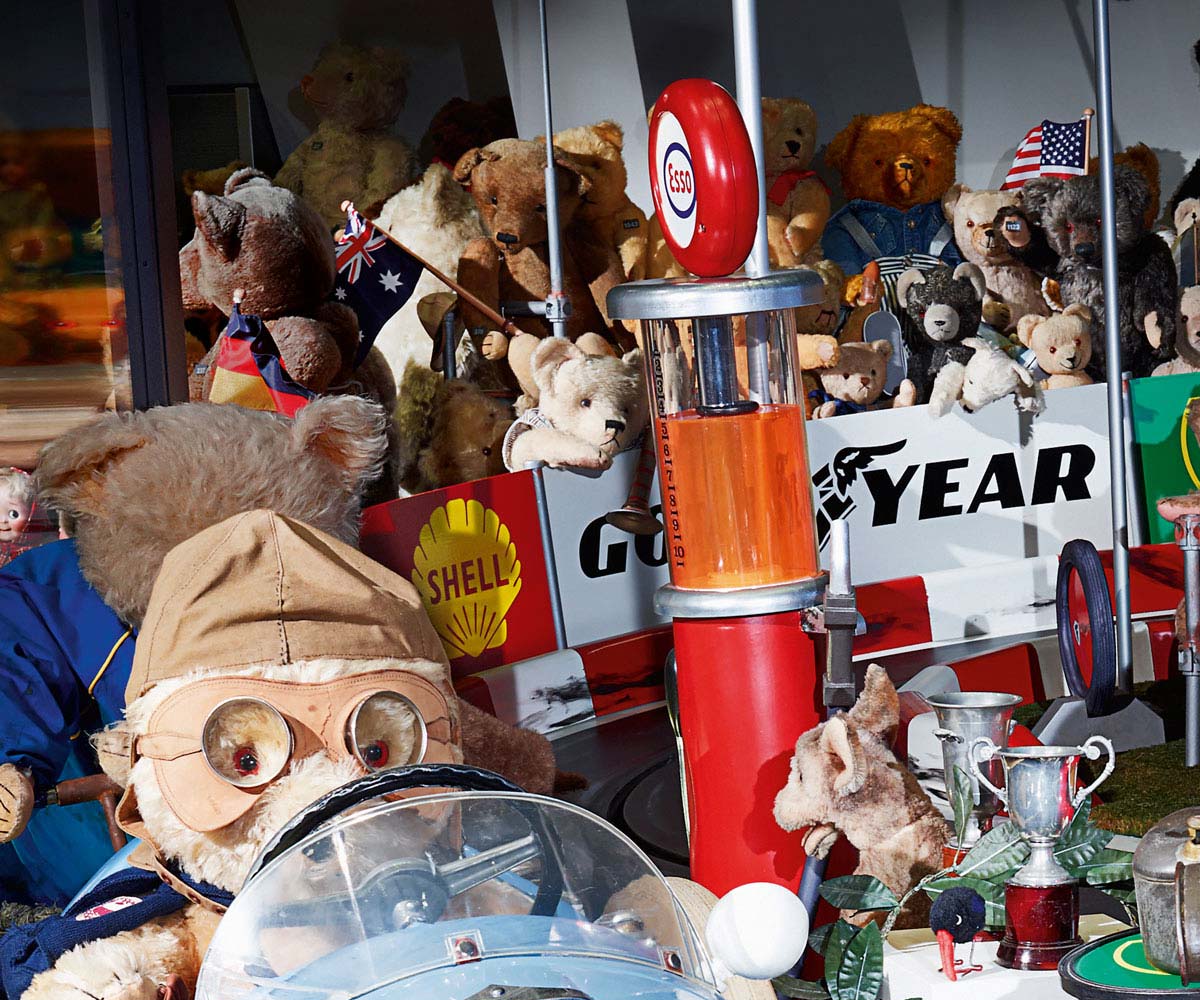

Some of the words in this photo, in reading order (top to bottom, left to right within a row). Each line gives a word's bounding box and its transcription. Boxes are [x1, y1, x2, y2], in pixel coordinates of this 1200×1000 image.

[657, 380, 664, 393] 3
[661, 422, 668, 434] 5
[663, 444, 670, 456] 6
[666, 470, 673, 481] 7
[669, 494, 676, 507] 8
[672, 518, 679, 531] 9
[674, 545, 685, 558] 10
[427, 553, 509, 605] SHELL
